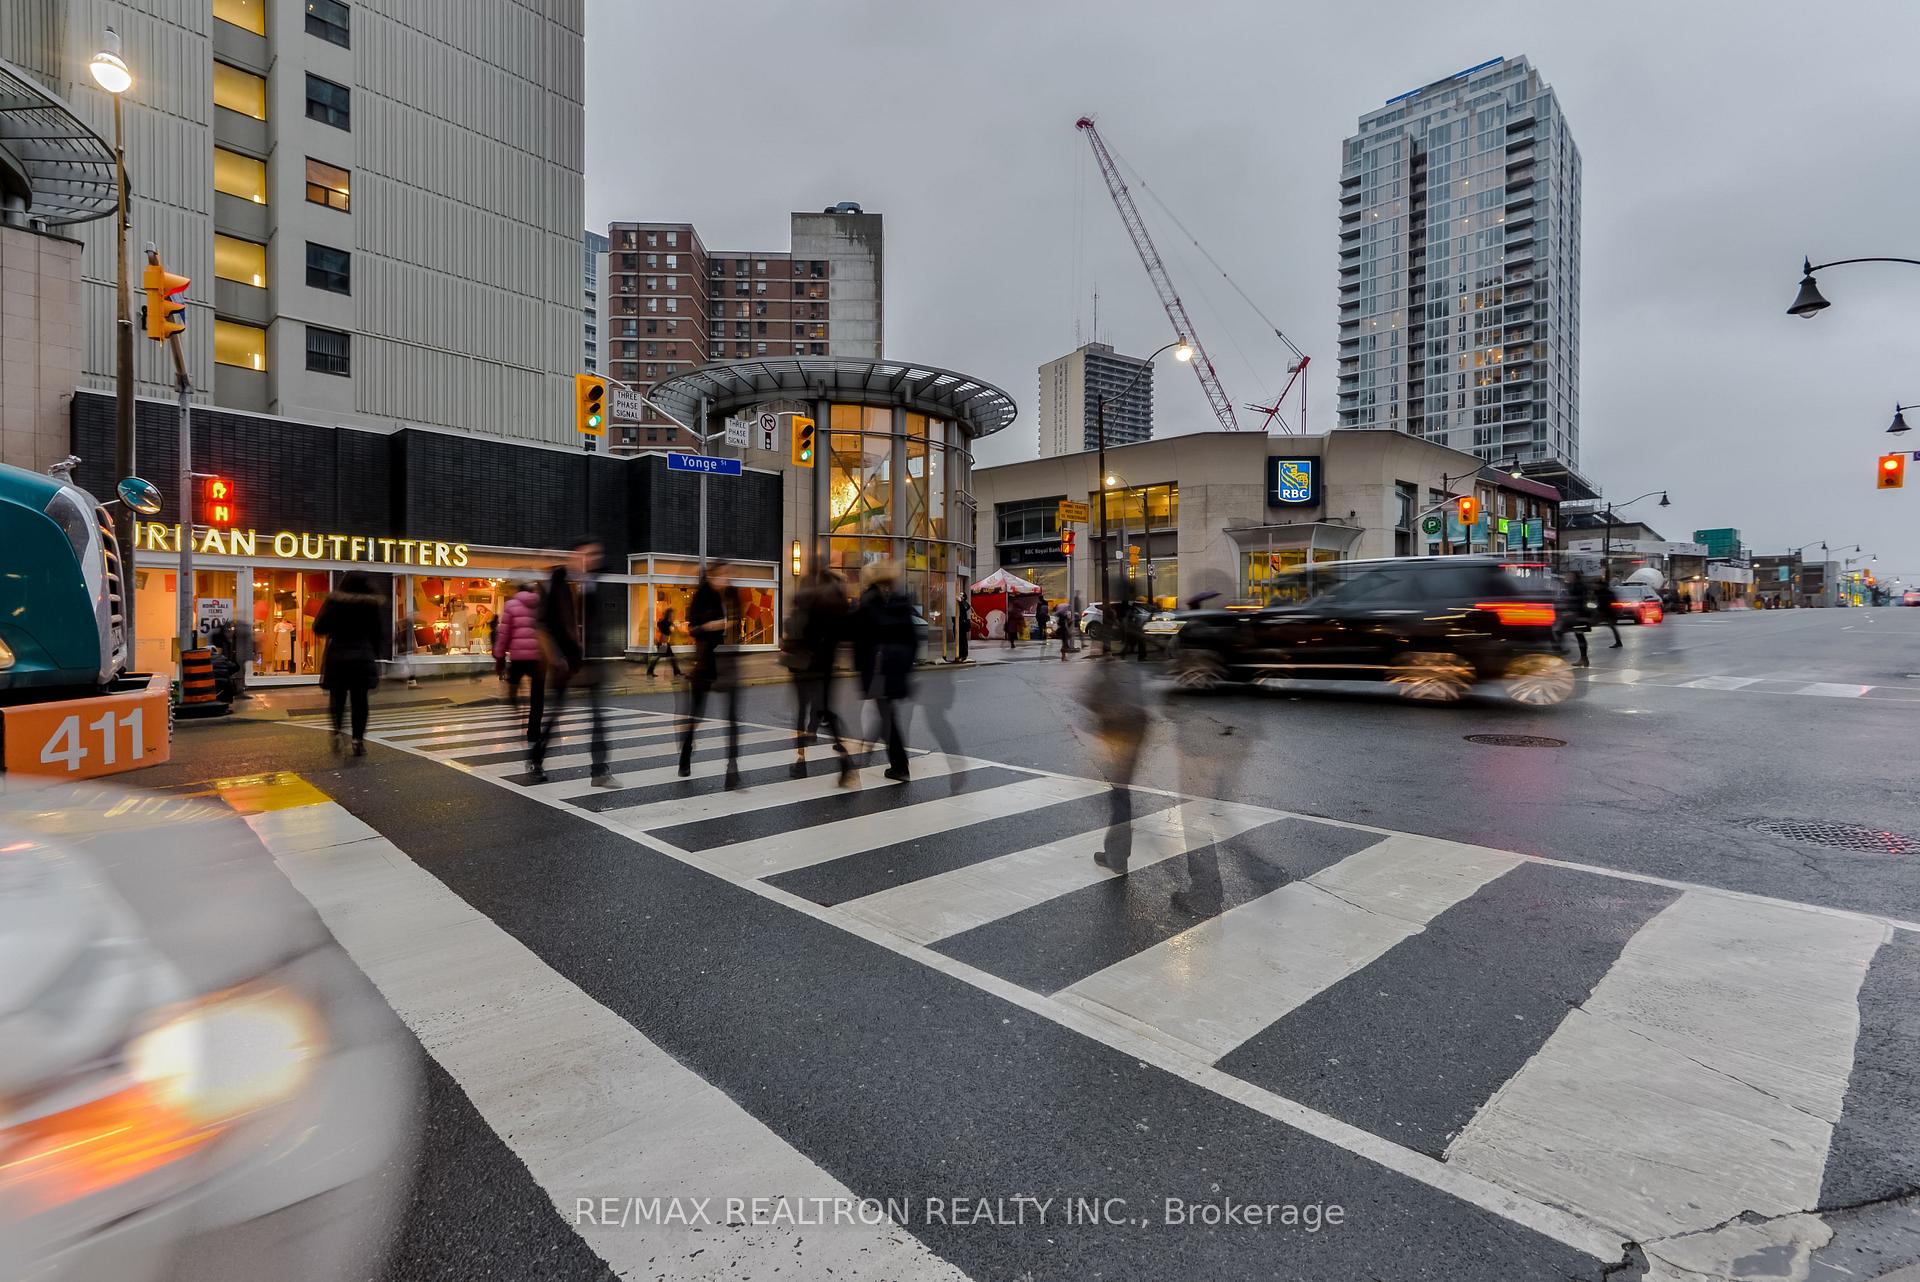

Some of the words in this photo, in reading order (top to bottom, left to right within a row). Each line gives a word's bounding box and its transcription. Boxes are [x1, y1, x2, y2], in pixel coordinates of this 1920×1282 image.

[618, 391, 637, 401] THREE
[616, 400, 638, 410] PHASE
[616, 409, 638, 419] SIGNAL
[729, 420, 746, 429] THREE
[728, 428, 747, 437] PHASE
[727, 437, 747, 446] SIGNAL
[681, 455, 717, 471] Yonge
[1282, 489, 1307, 498] RBC
[274, 531, 469, 567] OUTFITTERS
[40, 707, 144, 772] 411
